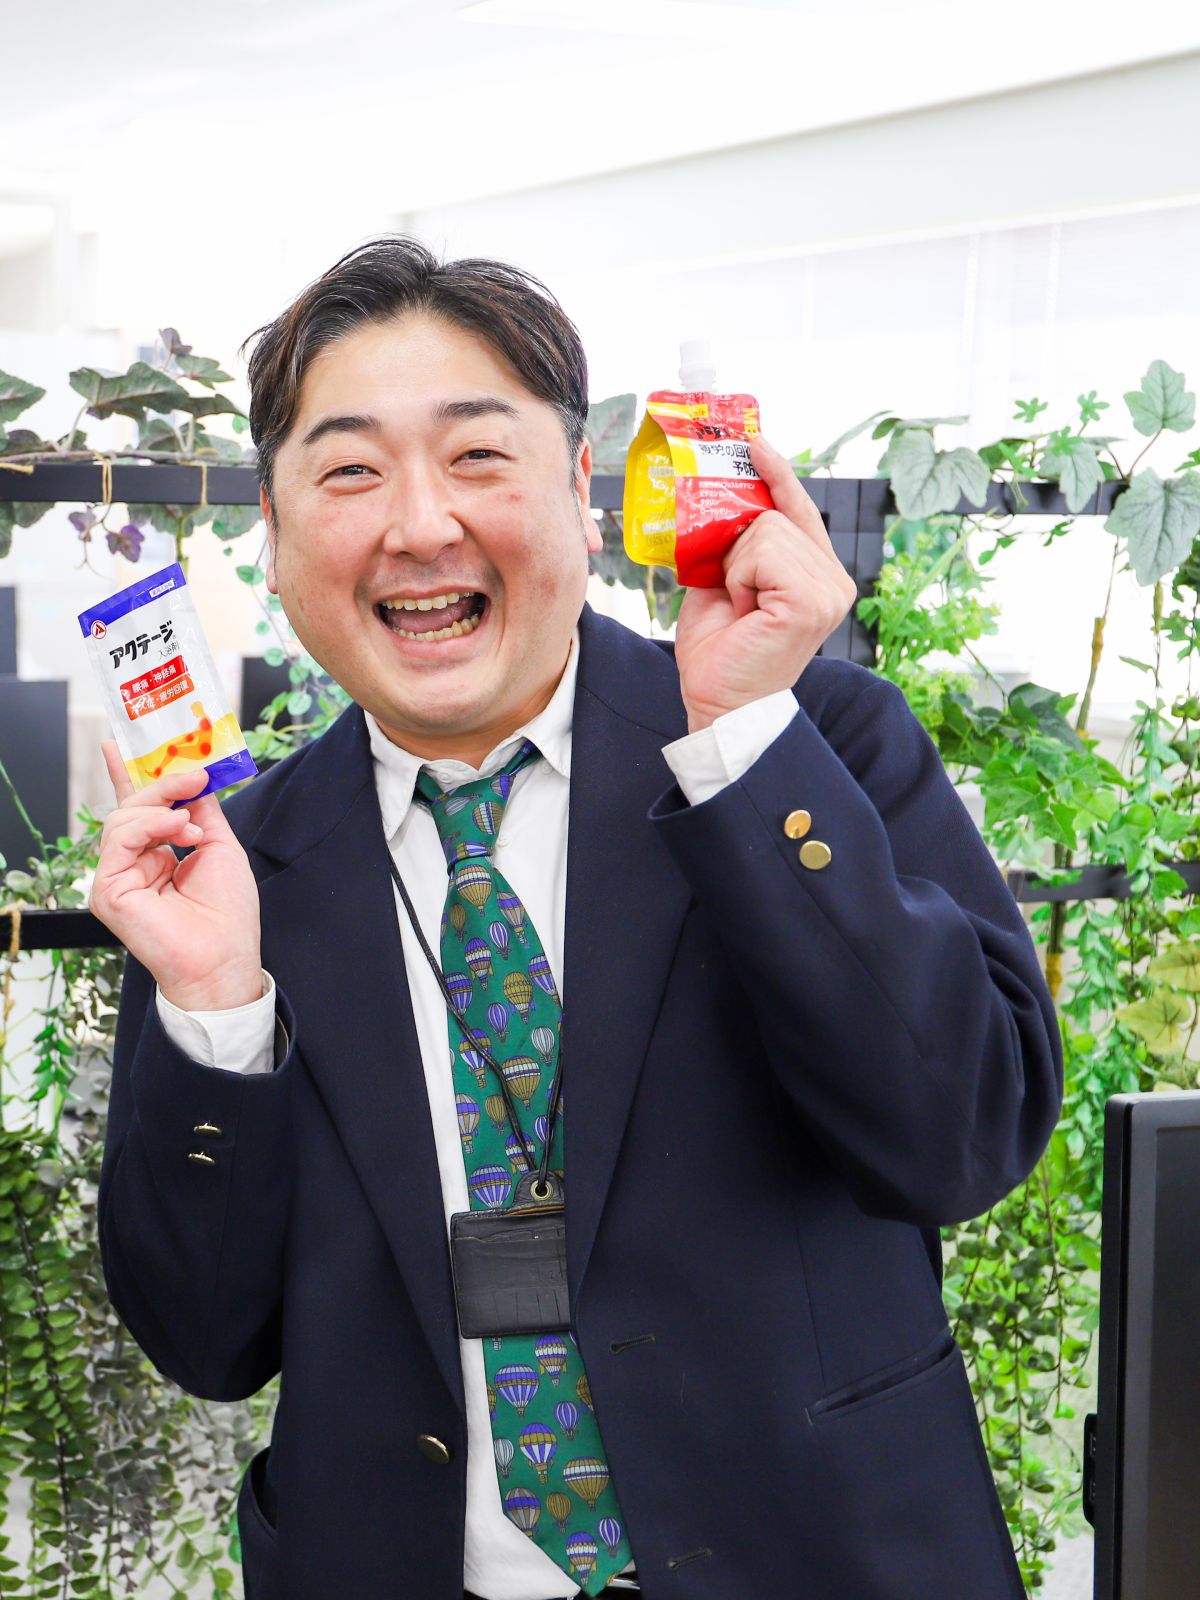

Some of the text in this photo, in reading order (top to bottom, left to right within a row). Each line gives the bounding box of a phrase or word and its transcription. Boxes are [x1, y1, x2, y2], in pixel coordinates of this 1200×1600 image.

[109, 620, 174, 669] アクテージ
